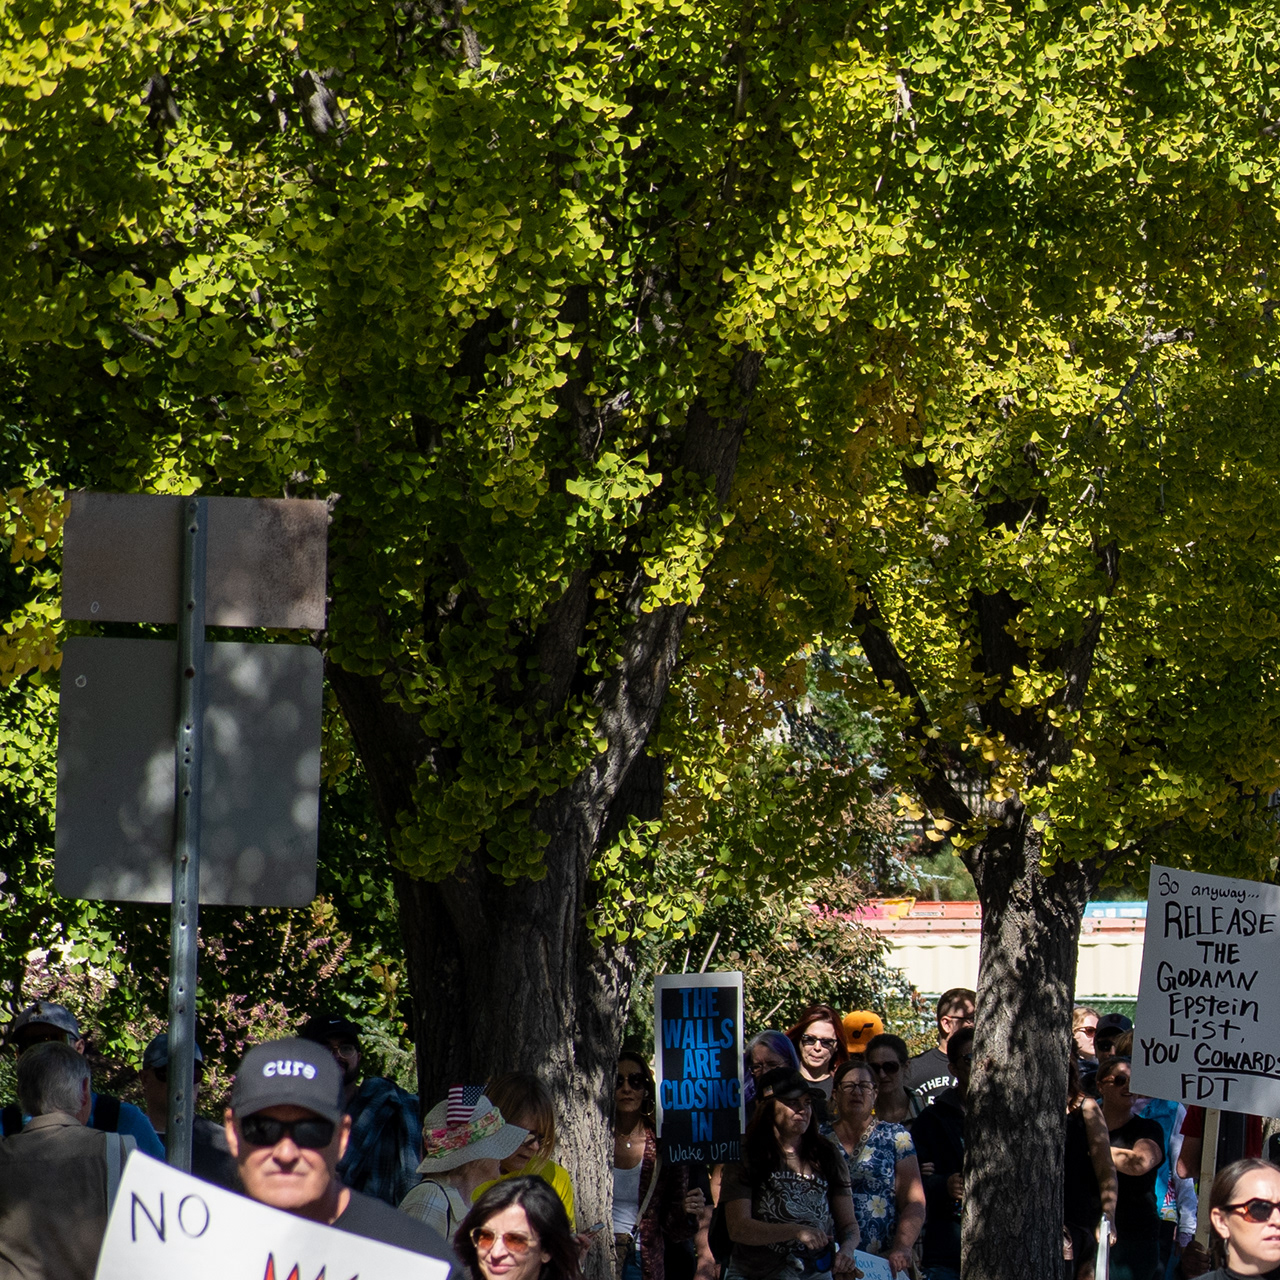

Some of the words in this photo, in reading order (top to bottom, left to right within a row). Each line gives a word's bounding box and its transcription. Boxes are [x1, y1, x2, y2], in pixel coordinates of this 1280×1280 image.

[1158, 872, 1180, 896] So
[1191, 884, 1260, 903] anyway...
[1164, 901, 1277, 940] RELEASE
[1196, 941, 1241, 965] THE
[1157, 961, 1258, 992] GODAMN
[679, 987, 719, 1018] THE
[1169, 992, 1259, 1022] Epstein
[663, 1018, 734, 1049] WALLS
[1169, 1018, 1245, 1044] List,
[683, 1049, 721, 1079] ARE
[1140, 1037, 1180, 1066] YOU
[263, 1059, 318, 1080] cure
[660, 1077, 741, 1111] CLOSING
[1181, 1073, 1239, 1102] FDT
[691, 1112, 714, 1143] IN
[668, 1144, 704, 1164] Wake
[130, 1191, 210, 1243] NO
